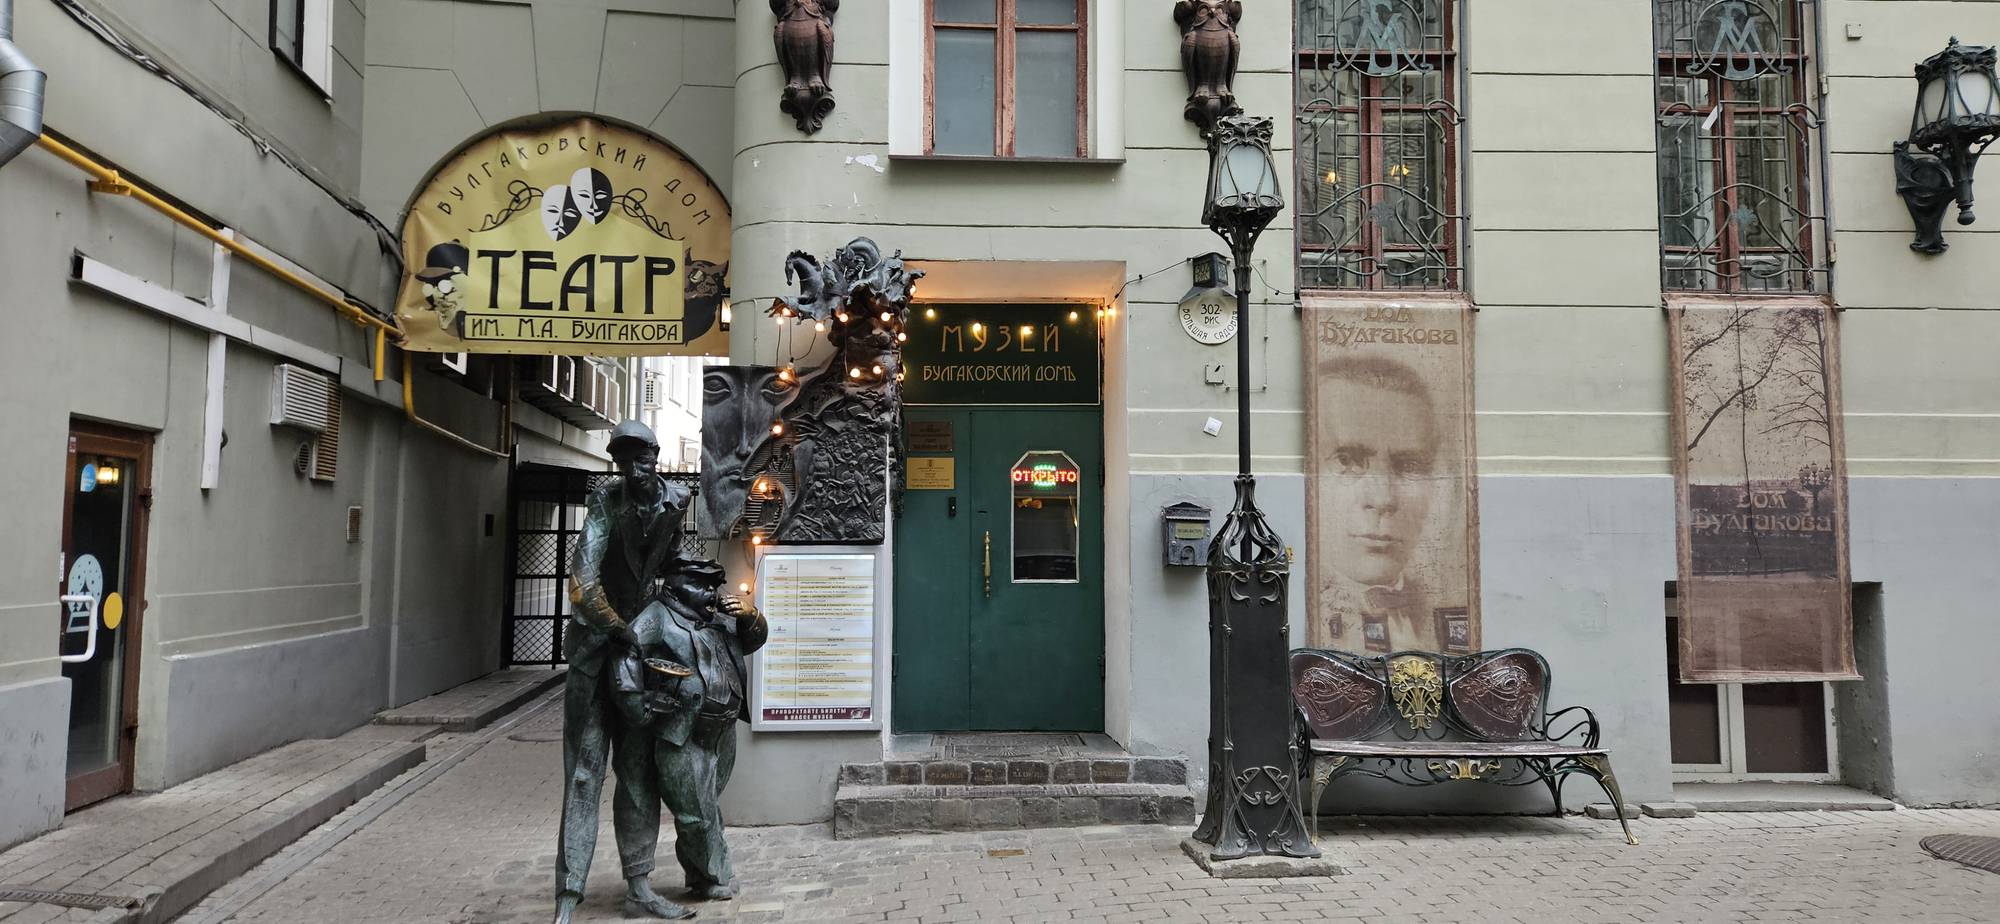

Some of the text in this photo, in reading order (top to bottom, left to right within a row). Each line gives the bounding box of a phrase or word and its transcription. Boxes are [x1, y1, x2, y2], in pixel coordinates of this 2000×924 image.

[437, 136, 711, 226] БУЛГАКОВСКИЙ ДОМ
[477, 249, 676, 315] ТЕАТР
[471, 318, 679, 342] ИМ. М.А. БУЛГАКОВА
[941, 323, 1060, 353] МУЗЕЙ
[1182, 308, 1208, 340] БОЛЬШАЯ
[923, 363, 1077, 382] БУЛГАКОВСКИЙ ДОМЪ
[1012, 470, 1078, 483] ОТКРЫТО
